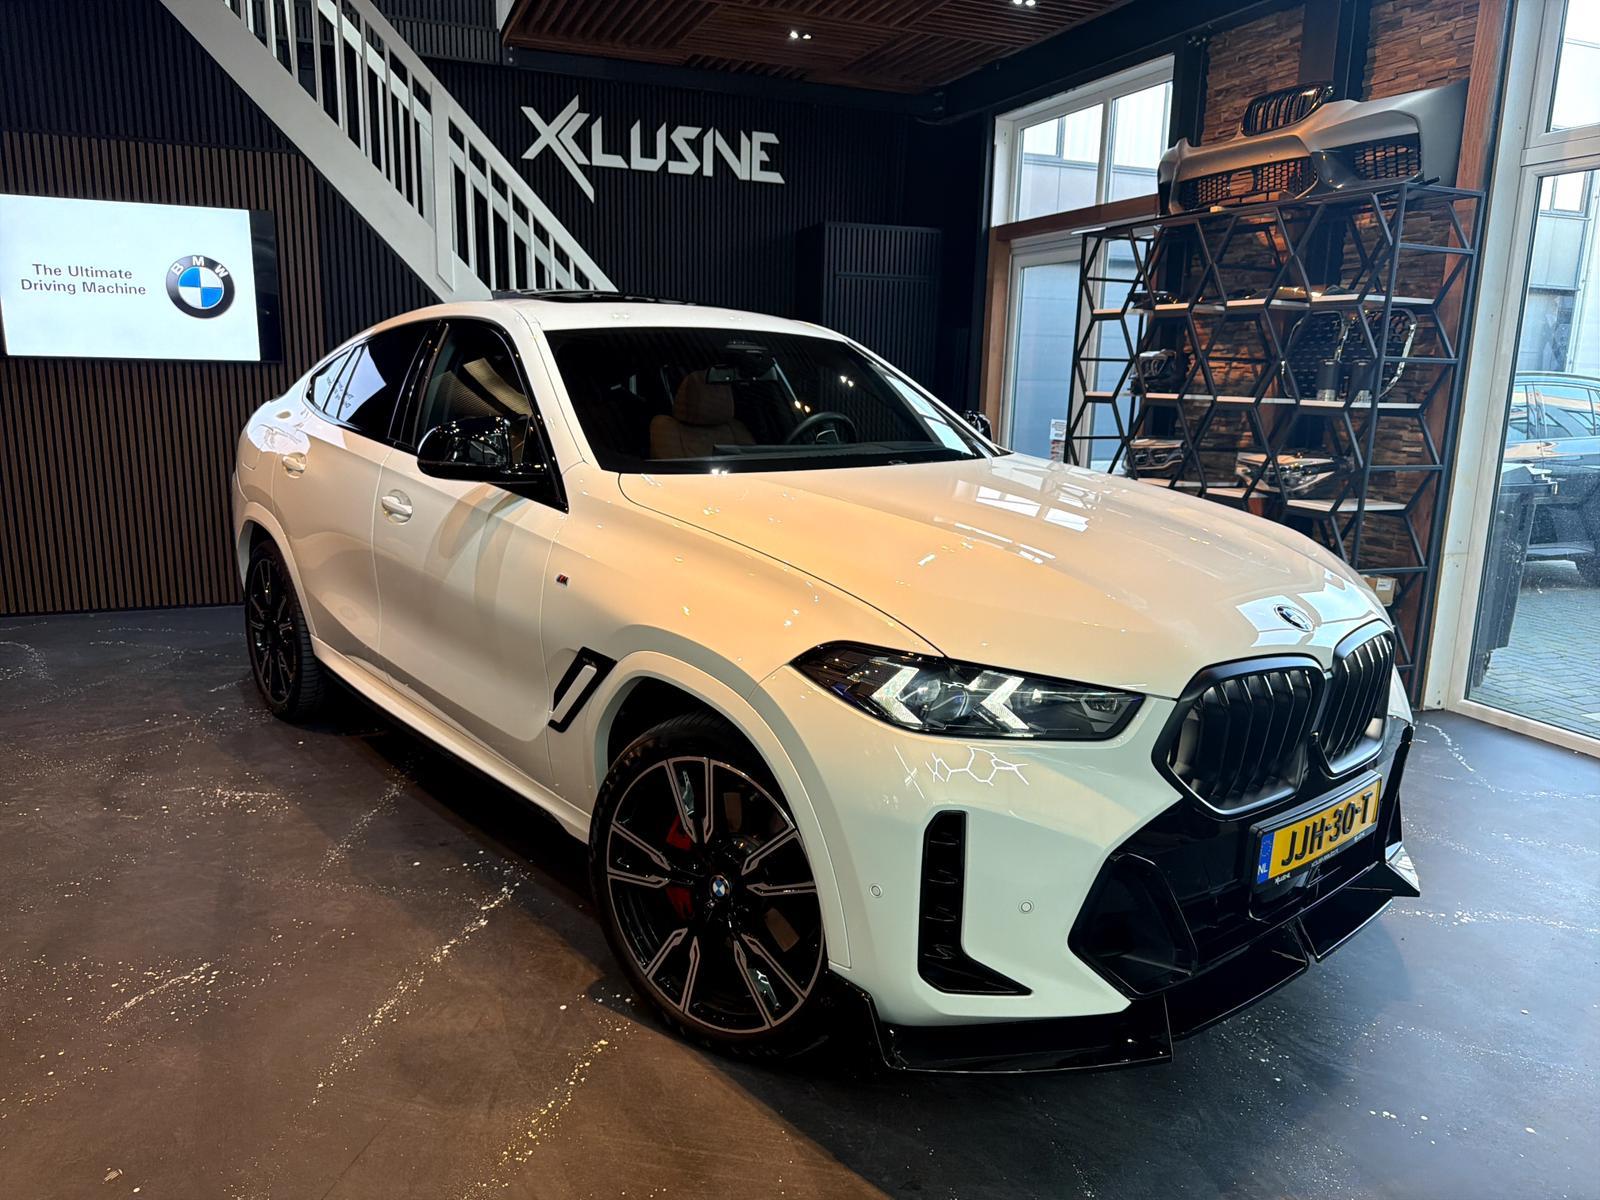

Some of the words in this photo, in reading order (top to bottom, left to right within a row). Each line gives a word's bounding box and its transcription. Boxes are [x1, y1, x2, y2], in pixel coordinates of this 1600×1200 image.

[32, 263, 62, 277] The
[68, 265, 133, 279] Ultimate
[170, 255, 229, 279] BMW
[21, 278, 76, 295] Driving
[82, 281, 147, 295] Machine
[1281, 791, 1373, 867] JJH-30-T
[1257, 863, 1268, 876] NL
